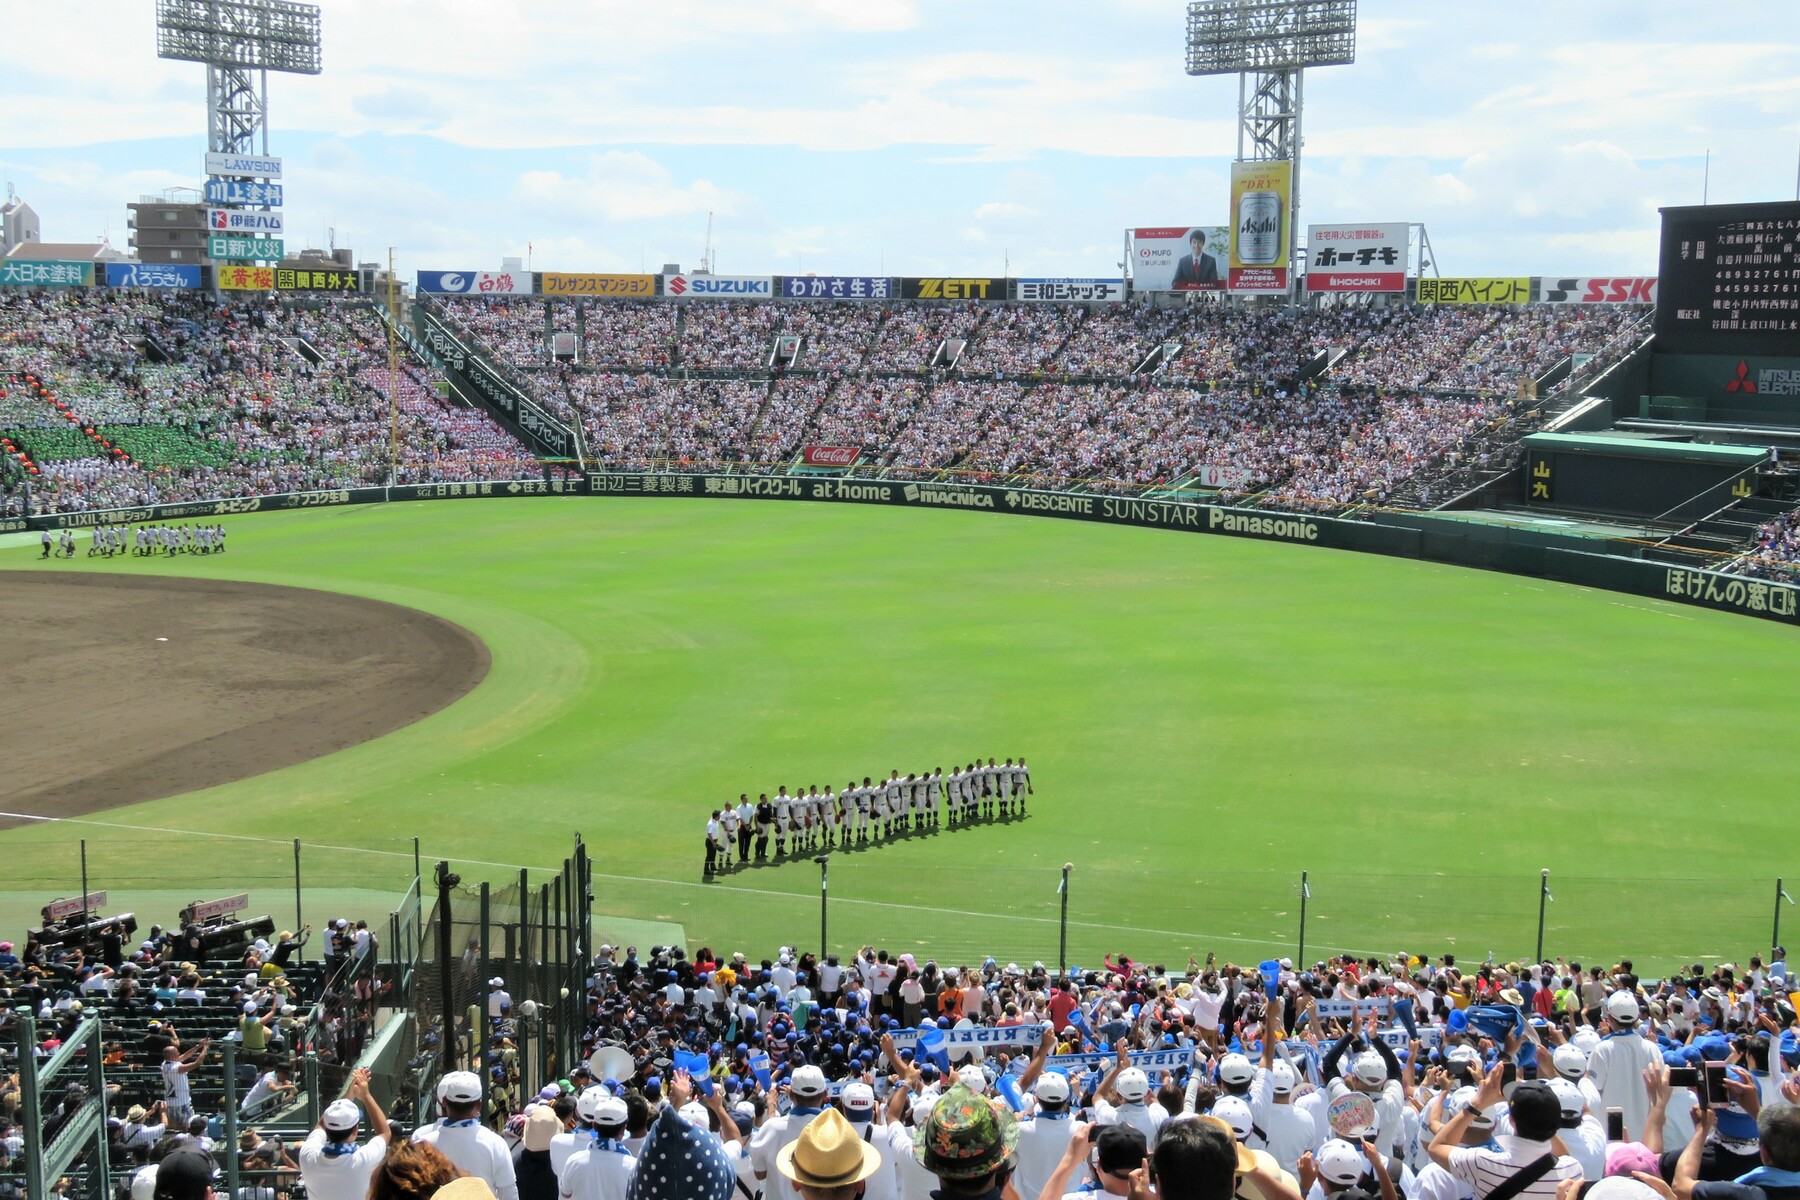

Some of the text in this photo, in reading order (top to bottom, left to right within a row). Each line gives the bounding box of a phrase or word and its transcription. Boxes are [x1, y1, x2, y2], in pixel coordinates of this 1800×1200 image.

[224, 158, 280, 173] LAWSON
[210, 183, 282, 206] 川上塗料
[230, 214, 282, 229] 伊藤ハム
[1241, 216, 1276, 234] Asahi
[1315, 231, 1385, 240] 住宅用火災警報器は
[212, 239, 280, 258] 日新火災
[1315, 247, 1398, 266] ホーチキ
[4, 264, 82, 286] 大日本塗料
[140, 272, 188, 287] ろうきん
[231, 268, 273, 288] 黄桜
[297, 272, 356, 289] 関西外大
[478, 274, 514, 292] 白鶴
[1337, 278, 1381, 286] HOCHIKI
[548, 277, 649, 292] プレサンスマンション
[692, 280, 769, 293] SUZUKI
[789, 279, 887, 298] わかさ生活
[918, 279, 991, 298] ZETT
[1024, 284, 1116, 300] 三和シャッター
[1420, 280, 1528, 303] 関西ペイント
[1582, 278, 1657, 302] SSK
[424, 327, 464, 370] 大同生命
[469, 370, 513, 411] 大日本住友製薬
[520, 410, 565, 451] 日興アセット
[523, 481, 577, 493] 住友電工
[591, 476, 693, 492] 田辺三菱製薬
[704, 478, 802, 496] 東進ハイスクール
[1532, 460, 1551, 499] 山九
[417, 489, 432, 497] SGL
[436, 483, 492, 496] 日鉄鋼板
[813, 478, 891, 500] at home
[214, 499, 260, 514] オービック
[301, 491, 349, 506] フコク生命
[1022, 494, 1093, 514] DESCENTE
[1103, 499, 1198, 526] SUNSTAR
[1210, 508, 1318, 540] Panasonic
[1666, 568, 1787, 615] ほけんの窓口
